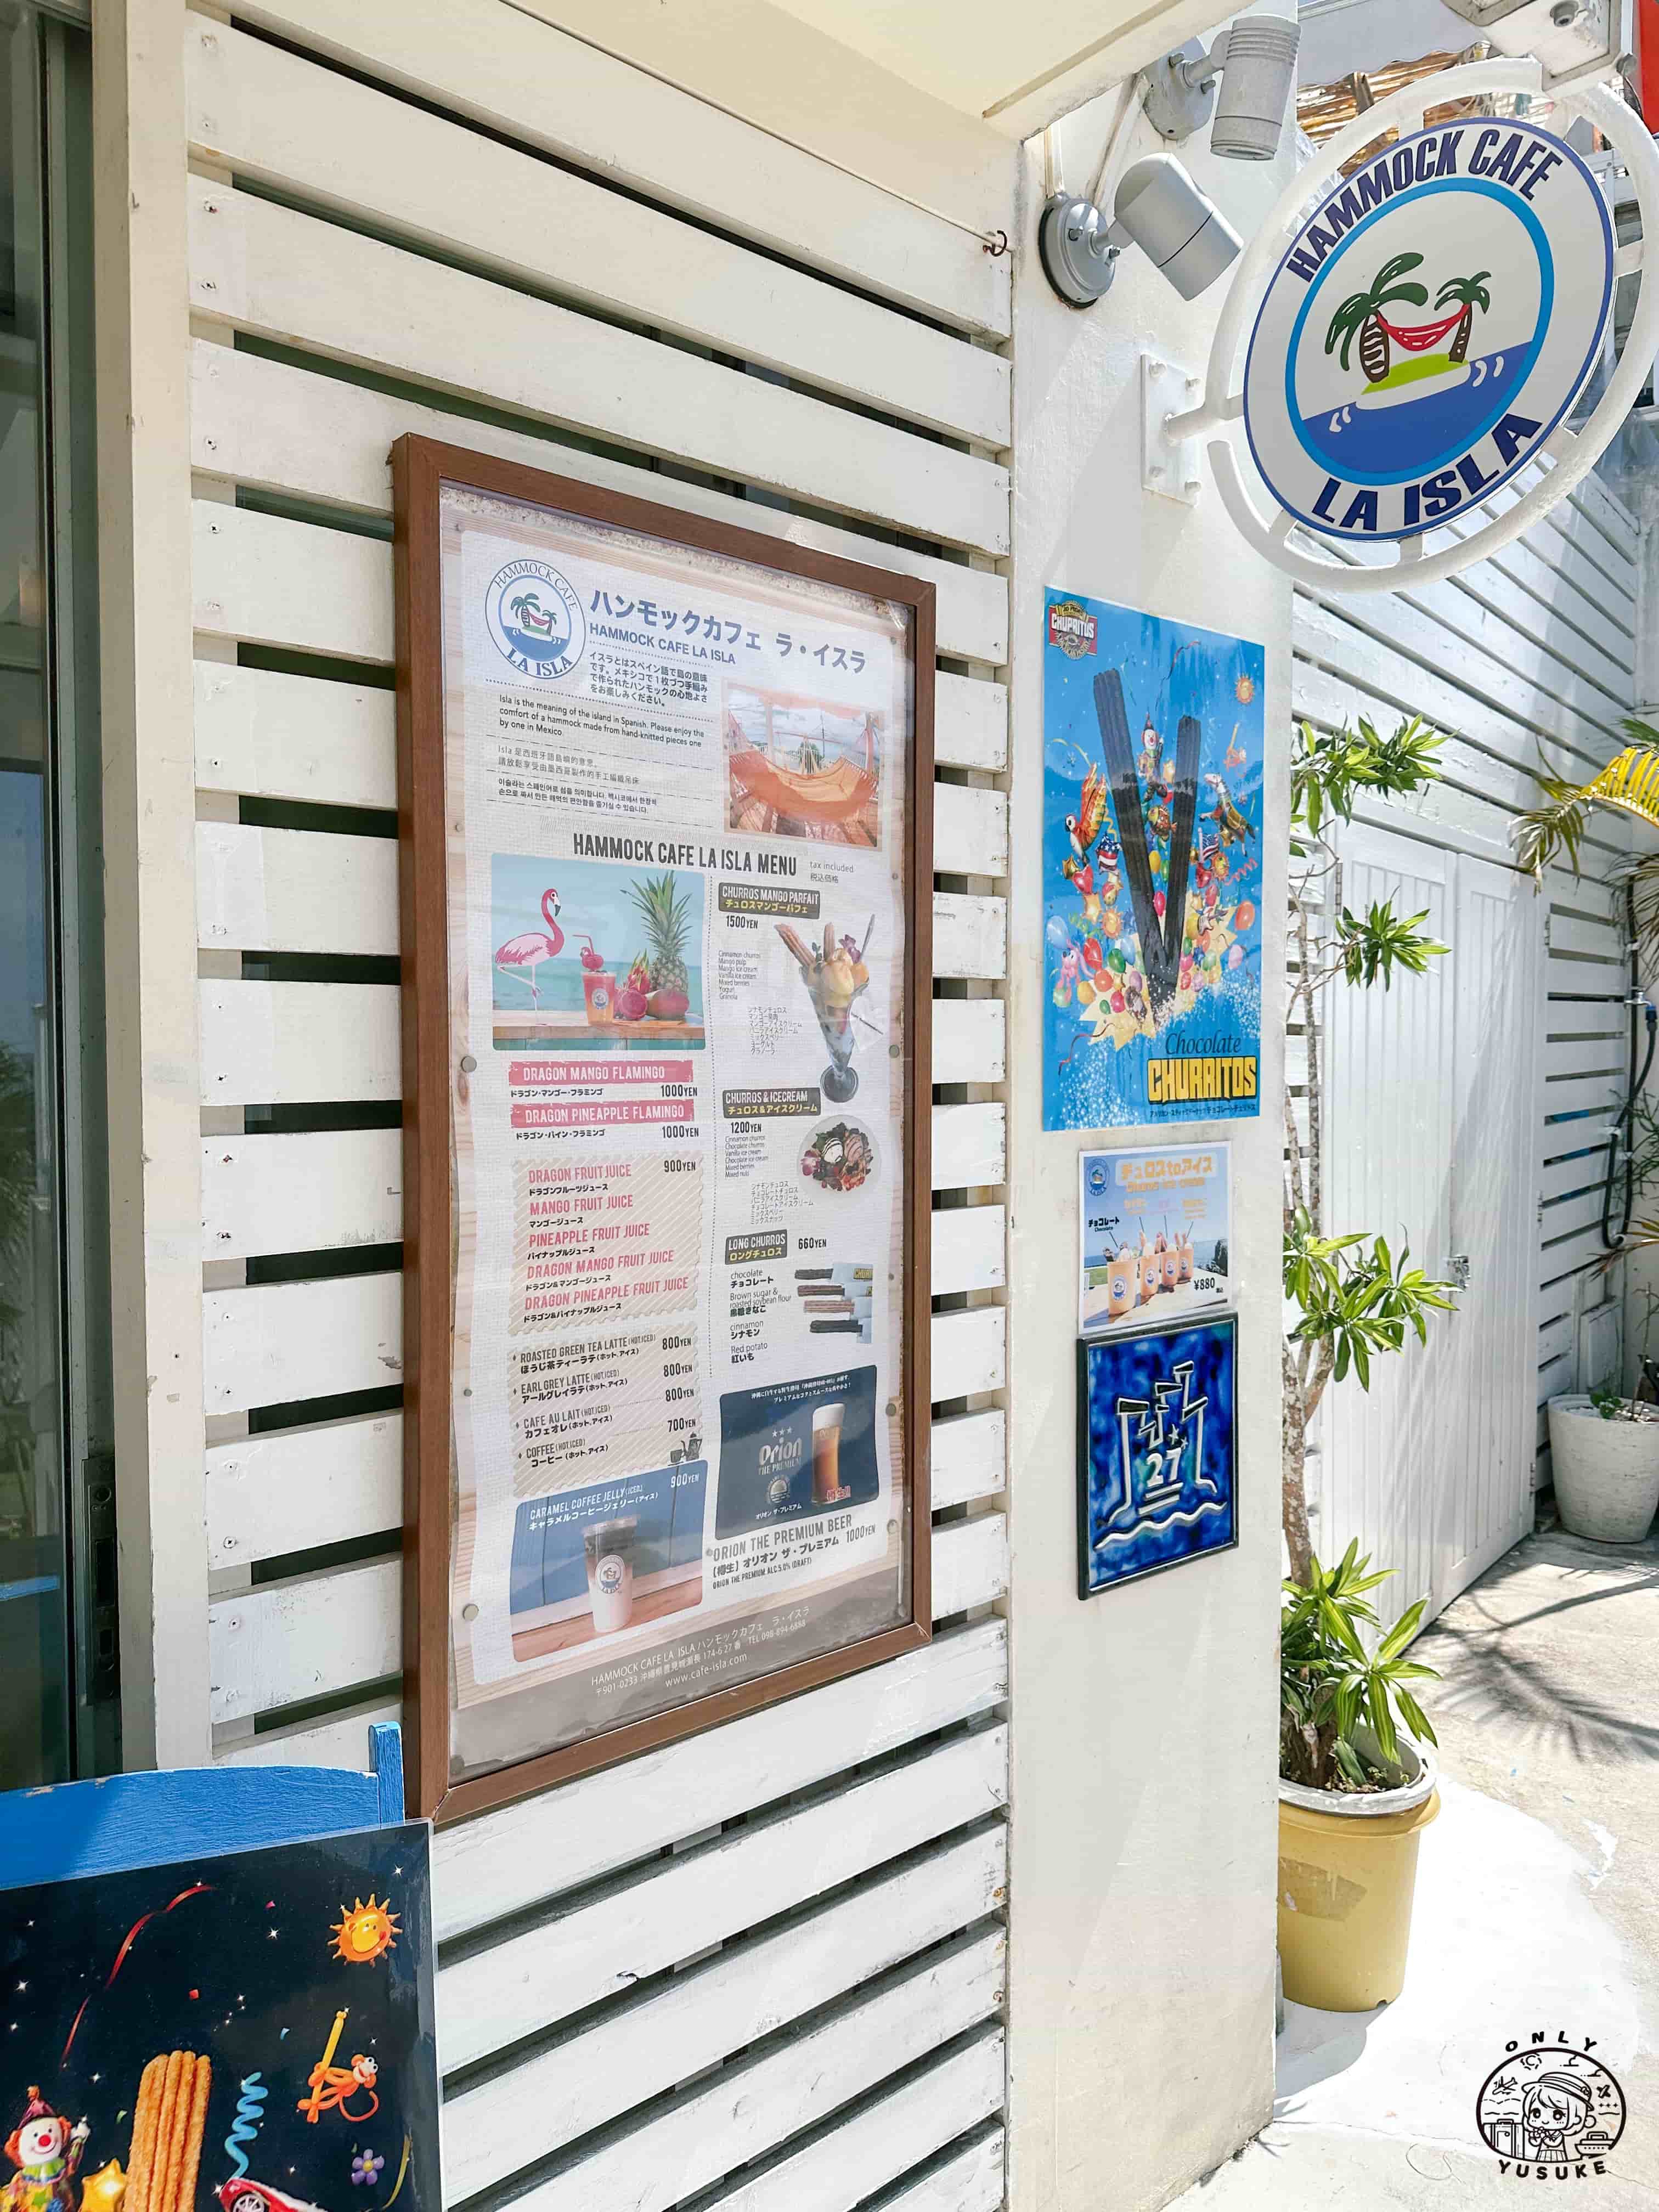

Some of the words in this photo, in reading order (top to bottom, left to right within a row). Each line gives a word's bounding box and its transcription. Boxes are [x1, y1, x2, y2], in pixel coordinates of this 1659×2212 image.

[1286, 129, 1464, 283] HAMMOCK
[1469, 128, 1564, 202] CAFE
[1312, 479, 1378, 533] LA
[1403, 413, 1543, 525] ISLA
[494, 562, 555, 589] HAMMOCK
[555, 578, 578, 611] CAFE
[590, 590, 761, 651] ハンモックカフェ
[776, 632, 865, 674] ラ・イスラ
[590, 623, 654, 648] HAMMOCK
[658, 639, 690, 655] CAFE
[692, 646, 707, 659] LA
[711, 649, 736, 664] ISLA
[507, 648, 529, 672] LA
[535, 655, 572, 676] ISLA
[500, 695, 512, 703] Isla
[514, 697, 520, 706] is
[522, 698, 534, 708] the
[537, 702, 567, 715] meaning
[569, 707, 577, 715] of
[578, 709, 590, 718] the
[592, 712, 611, 722] island
[621, 716, 648, 729] Spanish.
[651, 721, 672, 732] Please
[674, 727, 691, 737] enjoy
[693, 729, 704, 737] the
[500, 708, 529, 719] comfort
[531, 712, 539, 720] of
[548, 715, 581, 727] hammock
[583, 722, 602, 731] made
[604, 724, 620, 735] from
[622, 729, 664, 742] hand-knitted
[666, 736, 687, 744] pieces
[500, 717, 509, 729] by
[527, 723, 534, 731] in
[536, 724, 562, 736] Mexico
[573, 832, 654, 863] HAMMOCK
[658, 842, 694, 866] CAFE
[699, 846, 717, 868] LA
[721, 849, 752, 872] ISLA
[758, 854, 797, 876] MENU
[810, 860, 822, 870] tax
[823, 861, 854, 873] included
[723, 885, 760, 900] CHURROS
[760, 889, 789, 902] MANGO
[789, 892, 819, 905] PARFAIT
[725, 899, 808, 913] チュロスマンゴーパフェ
[726, 915, 758, 929] 1500YEN
[1166, 1029, 1242, 1054] Chocolate
[523, 1066, 567, 1081] DRAGON
[570, 1066, 608, 1080] MANGO
[612, 1066, 665, 1080] FLAMINGO
[1148, 1056, 1257, 1105] CHURRITOS
[661, 1084, 698, 1098] 1000YEN
[726, 1091, 762, 1104] CHURROS
[770, 1090, 808, 1103] ICECREAM
[525, 1109, 568, 1124] DRAGON
[571, 1107, 629, 1121] PINEAPPLE
[633, 1104, 684, 1119] FLAMINGO
[728, 1104, 817, 1115] チュロス&アイスクリーム
[662, 1125, 699, 1138] 1000YEN
[731, 1121, 762, 1133] 1200YEN
[664, 1159, 696, 1172] 900YEN
[528, 1168, 571, 1183] DRAGON
[575, 1165, 603, 1180] FRUIT
[605, 1164, 632, 1178] JUICE
[529, 1183, 608, 1197] ドラゴンフルーツジュース
[529, 1200, 570, 1216] MANGO
[574, 1197, 603, 1211] FRUIT
[606, 1194, 633, 1209] JUICE
[529, 1217, 583, 1228] マンゴージュース
[1088, 1216, 1119, 1228] チョコレート
[529, 1229, 588, 1248] PINEAPPLE
[592, 1226, 621, 1241] FRUIT
[623, 1223, 650, 1238] JUICE
[729, 1238, 749, 1251] LONG
[751, 1234, 786, 1248] CHURROS
[798, 1238, 827, 1250] 660YEN
[527, 1246, 595, 1260] パイナップルジュース
[730, 1247, 782, 1261] ロングチュロス
[527, 1262, 572, 1279] DRAGON
[575, 1257, 614, 1273] MANGO
[618, 1253, 646, 1268] FRUIT
[648, 1250, 675, 1265] JUICE
[731, 1268, 763, 1279] chocolate
[730, 1277, 774, 1288] チョコレート
[1194, 1277, 1215, 1291] ¥880
[525, 1293, 569, 1311] DRAGON
[573, 1285, 629, 1303] PINEAPPLE
[633, 1280, 659, 1295] FRUIT
[662, 1277, 689, 1292] JUICE
[730, 1292, 752, 1301] Brown
[730, 1299, 752, 1308] roasted
[778, 1294, 792, 1304] flour
[730, 1321, 764, 1331] cinnamon
[731, 1329, 760, 1340] シナモン
[521, 1349, 556, 1363] ROASTED
[559, 1343, 585, 1357] GREEN
[588, 1340, 602, 1352] TEA
[605, 1337, 627, 1350] LATTE
[662, 1336, 691, 1350] 800YEN
[731, 1345, 744, 1354] Red
[746, 1342, 768, 1353] potato
[731, 1352, 754, 1364] 紅いも
[663, 1363, 692, 1377] 800YEN
[521, 1381, 542, 1394] EARL
[544, 1378, 564, 1390] GREY
[566, 1374, 590, 1386] LATTE
[665, 1387, 694, 1402] 800YEN
[523, 1415, 545, 1429] CAFE
[549, 1412, 560, 1423] AU
[562, 1408, 580, 1421] LAIT
[668, 1418, 696, 1432] 700YEN
[526, 1443, 555, 1458] COFFEE
[759, 1437, 802, 1465] Orion
[532, 1455, 562, 1468] コーヒー
[1147, 1447, 1182, 1487] 27
[670, 1473, 699, 1488] 900YEN
[531, 1504, 569, 1520] CARAMEL
[572, 1493, 601, 1509] COFFEE
[602, 1487, 625, 1500] JELLY
[713, 1542, 746, 1562] ORION
[751, 1537, 769, 1552] THE
[774, 1521, 823, 1545] PREMIUM
[828, 1514, 852, 1533] BEER
[847, 1524, 876, 1543] 1000YEN
[743, 1552, 777, 1568] オリオン
[781, 1537, 839, 1559] ザ・プレミアム
[591, 1662, 639, 1686] HAMMOCK
[640, 1653, 662, 1670] CAFE
[664, 1649, 674, 1662] LA
[678, 1643, 695, 1657] ISLA
[697, 1623, 763, 1650] ハンモックカフェ
[665, 1653, 747, 1688] www.cafe-isla.com
